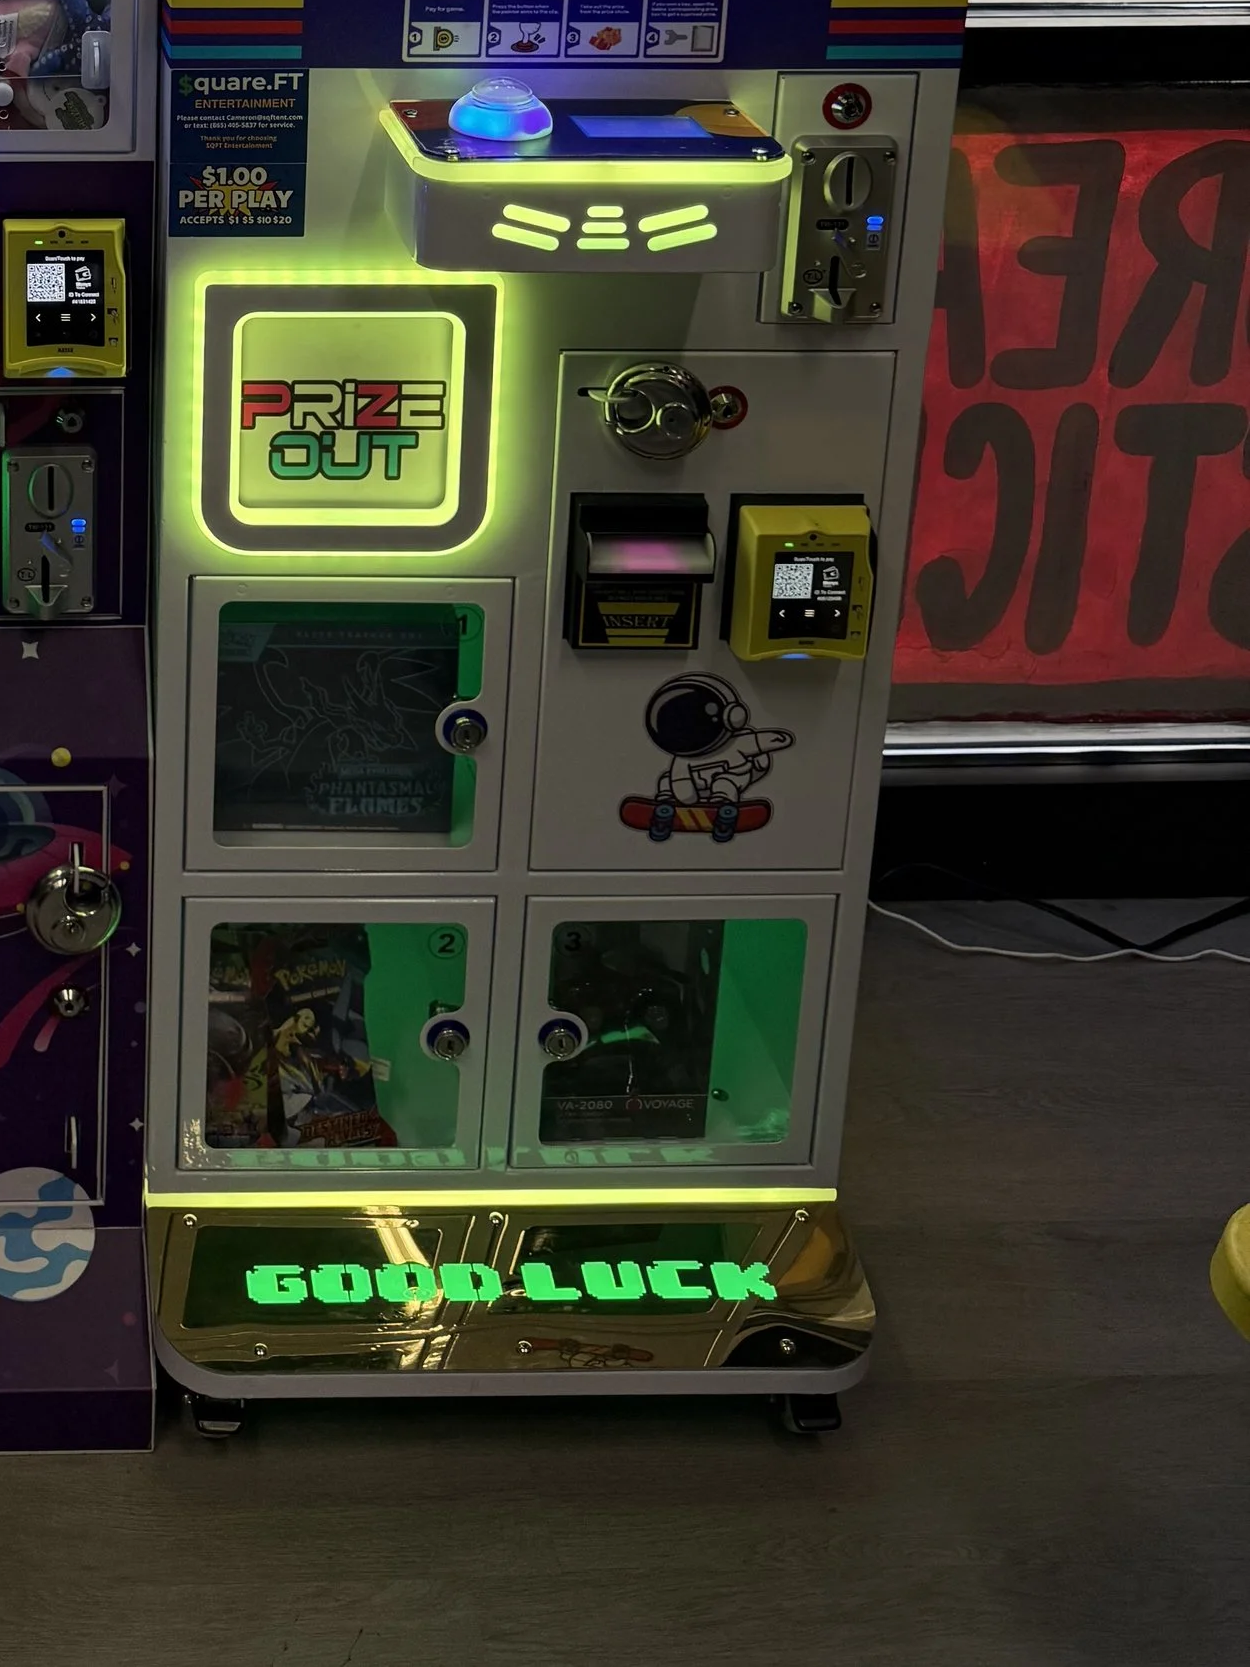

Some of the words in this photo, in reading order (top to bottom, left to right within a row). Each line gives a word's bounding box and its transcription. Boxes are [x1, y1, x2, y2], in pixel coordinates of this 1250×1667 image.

[412, 33, 419, 42] 1
[490, 33, 497, 42] 2
[569, 33, 576, 42] 3
[649, 33, 656, 42] 4
[178, 72, 304, 97] $quare.FT
[194, 98, 296, 109] ENTERTAINMENT
[202, 165, 268, 187] $1.00
[178, 189, 225, 209] PER
[230, 189, 294, 209] PLAY
[179, 215, 224, 225] ACCEPTS
[228, 215, 239, 226] $1
[242, 215, 254, 225] $5
[256, 215, 271, 225] $10
[272, 215, 293, 225] $20
[269, 430, 420, 481] OUT
[457, 614, 468, 635] 1
[603, 614, 675, 629] INSERT
[437, 934, 456, 954] 2
[564, 932, 582, 952] 3
[557, 1100, 613, 1111] VA-2080
[643, 1098, 694, 1110] VOYAGE
[246, 1263, 503, 1303] GOOD
[520, 1261, 778, 1302] LUCK
